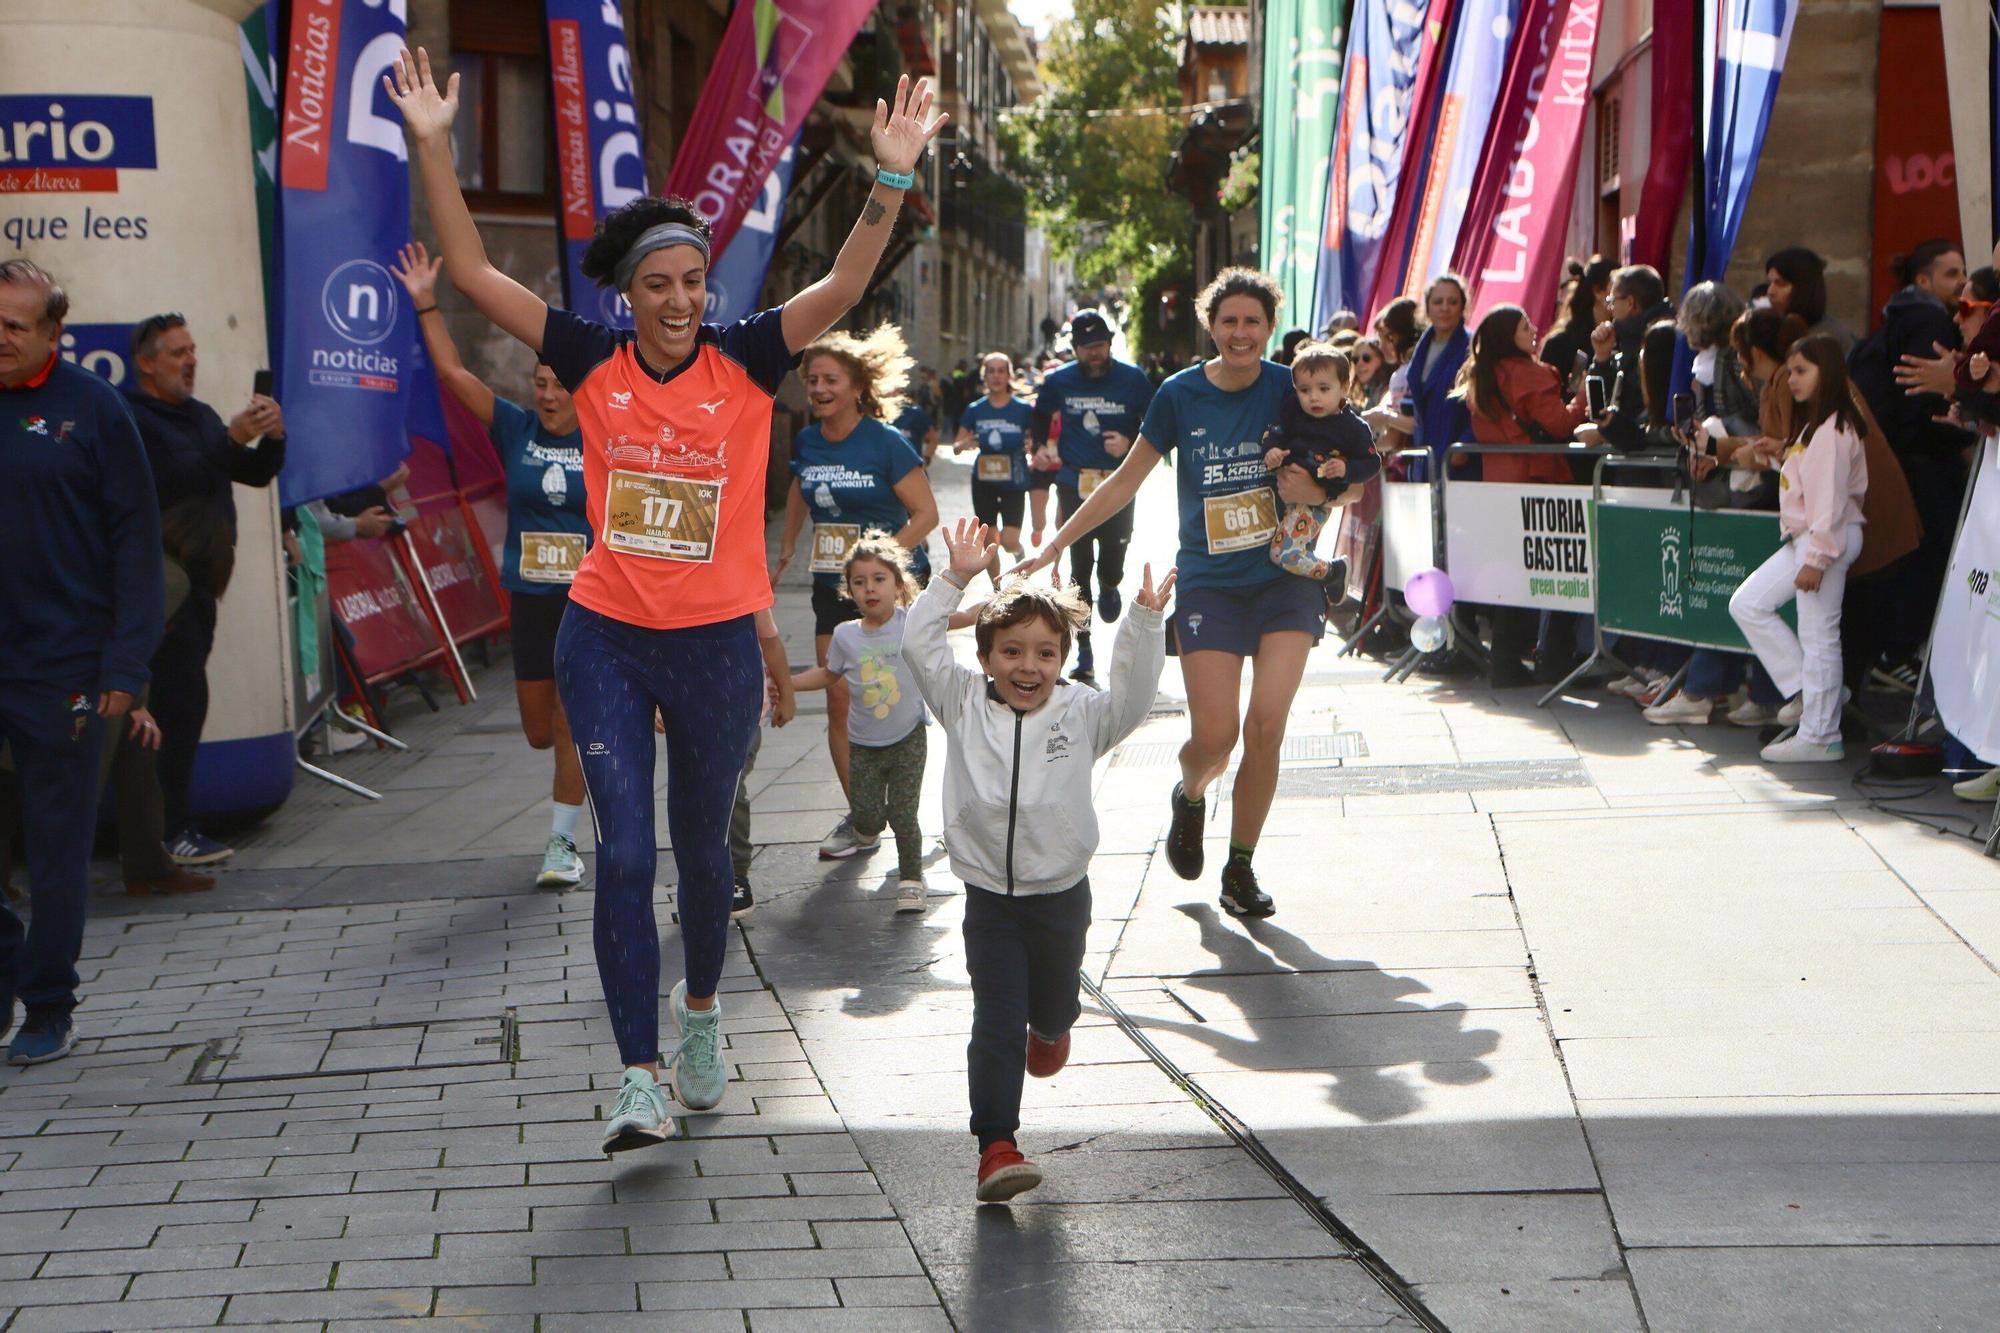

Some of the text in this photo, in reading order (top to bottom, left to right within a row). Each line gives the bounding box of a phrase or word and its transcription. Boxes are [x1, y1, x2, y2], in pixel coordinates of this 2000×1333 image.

[287, 12, 333, 155] Noticias
[0, 103, 115, 162] rio
[3, 205, 148, 250] que lees
[312, 348, 398, 374] noticias
[640, 496, 683, 529] 177
[1223, 503, 1260, 531] 661
[1521, 496, 1586, 534] VITORIA
[537, 545, 567, 565] 601
[1523, 535, 1588, 574] GASTEIZ
[1529, 576, 1590, 600] green capital
